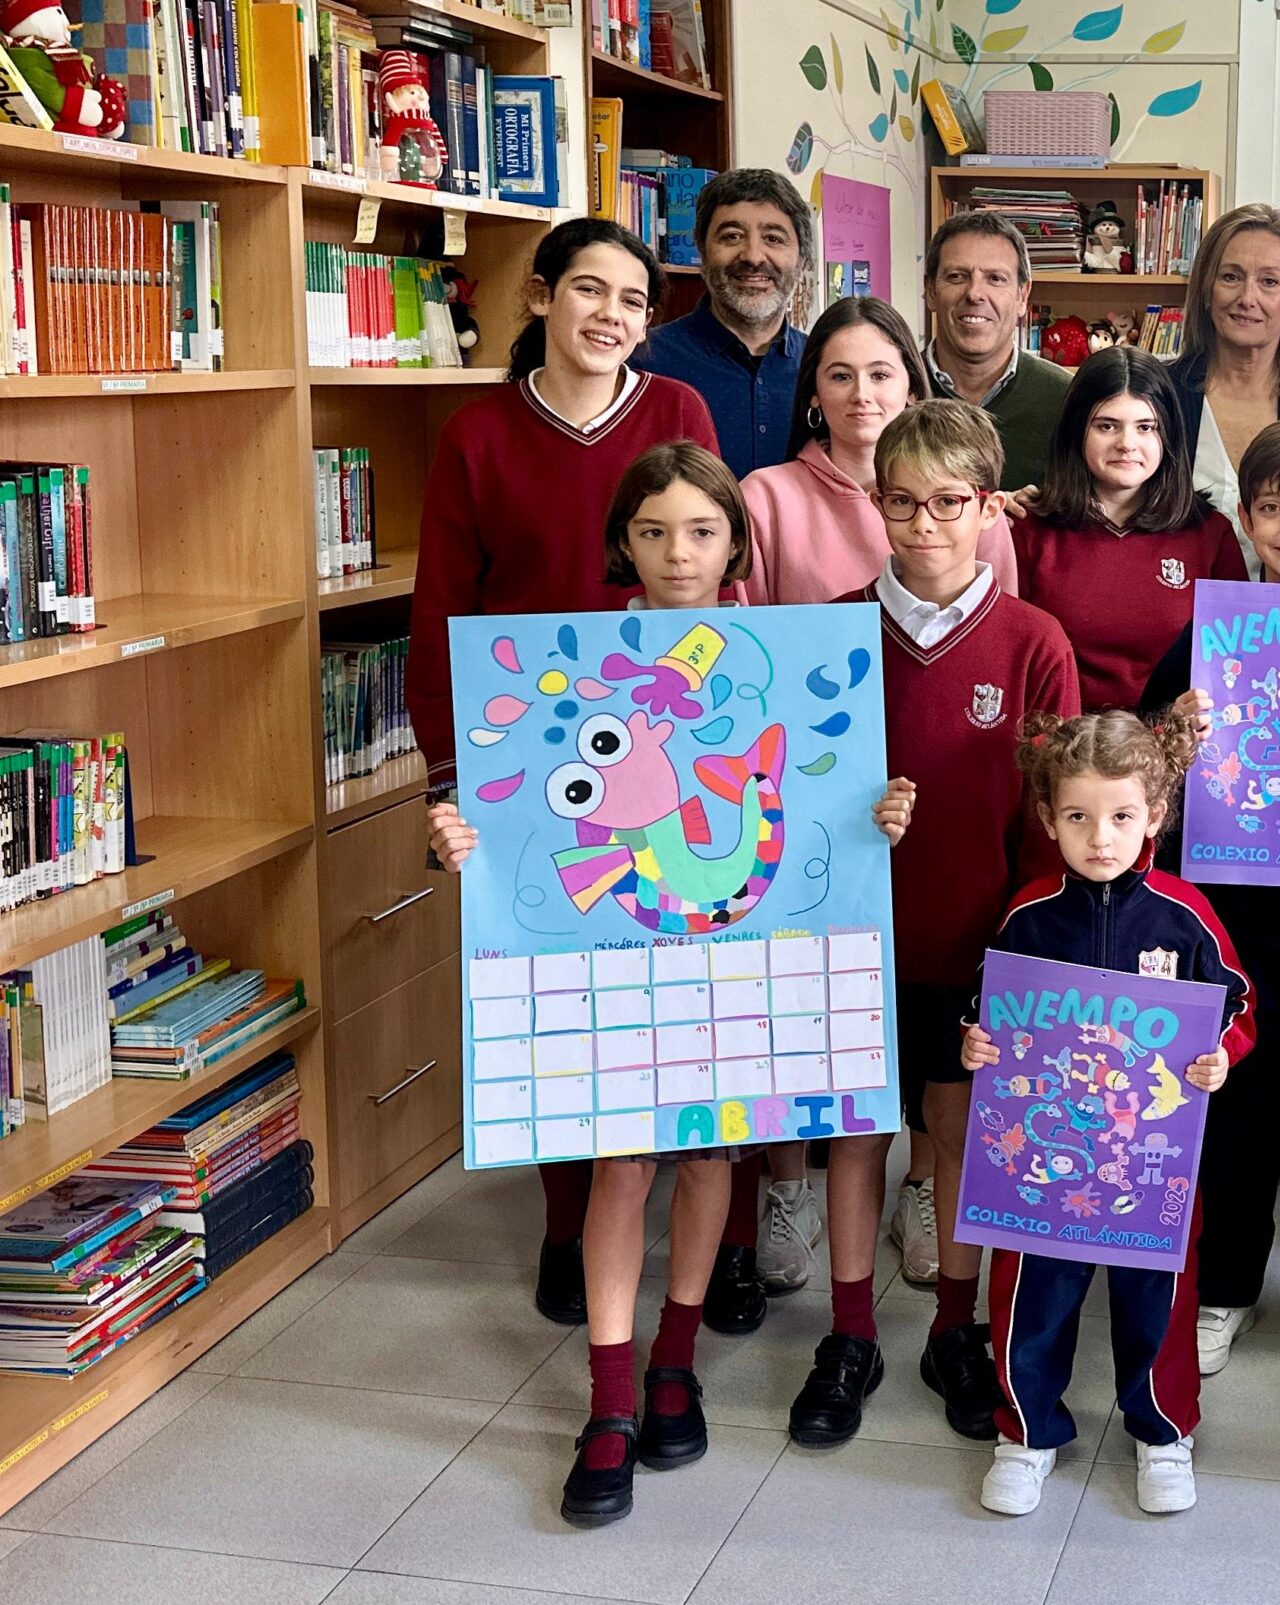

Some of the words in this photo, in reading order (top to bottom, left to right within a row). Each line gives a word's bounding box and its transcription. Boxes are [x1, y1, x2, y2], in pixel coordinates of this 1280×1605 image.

[495, 118, 504, 168] EVEREST
[504, 108, 520, 176] ORTOGRAFÍA
[1191, 843, 1270, 863] COLEXIO
[474, 948, 508, 960] LUNS
[652, 936, 694, 948] XOVES
[712, 932, 762, 944] VENRES
[580, 954, 586, 962] 1
[872, 934, 878, 942] 6
[643, 988, 650, 996] 9
[756, 980, 762, 988] 11
[869, 973, 878, 981] 13
[696, 1024, 708, 1033] 17
[757, 1020, 768, 1029] 18
[870, 1014, 880, 1022] 20
[988, 988, 1180, 1049] AVEMPO
[870, 1052, 882, 1060] 27
[578, 1118, 590, 1127] 29
[676, 1094, 876, 1147] ABRIL
[1159, 1176, 1189, 1226] 2025
[965, 1204, 1051, 1234] COLEXIO
[1058, 1224, 1172, 1250] ATLÁNTIDA
